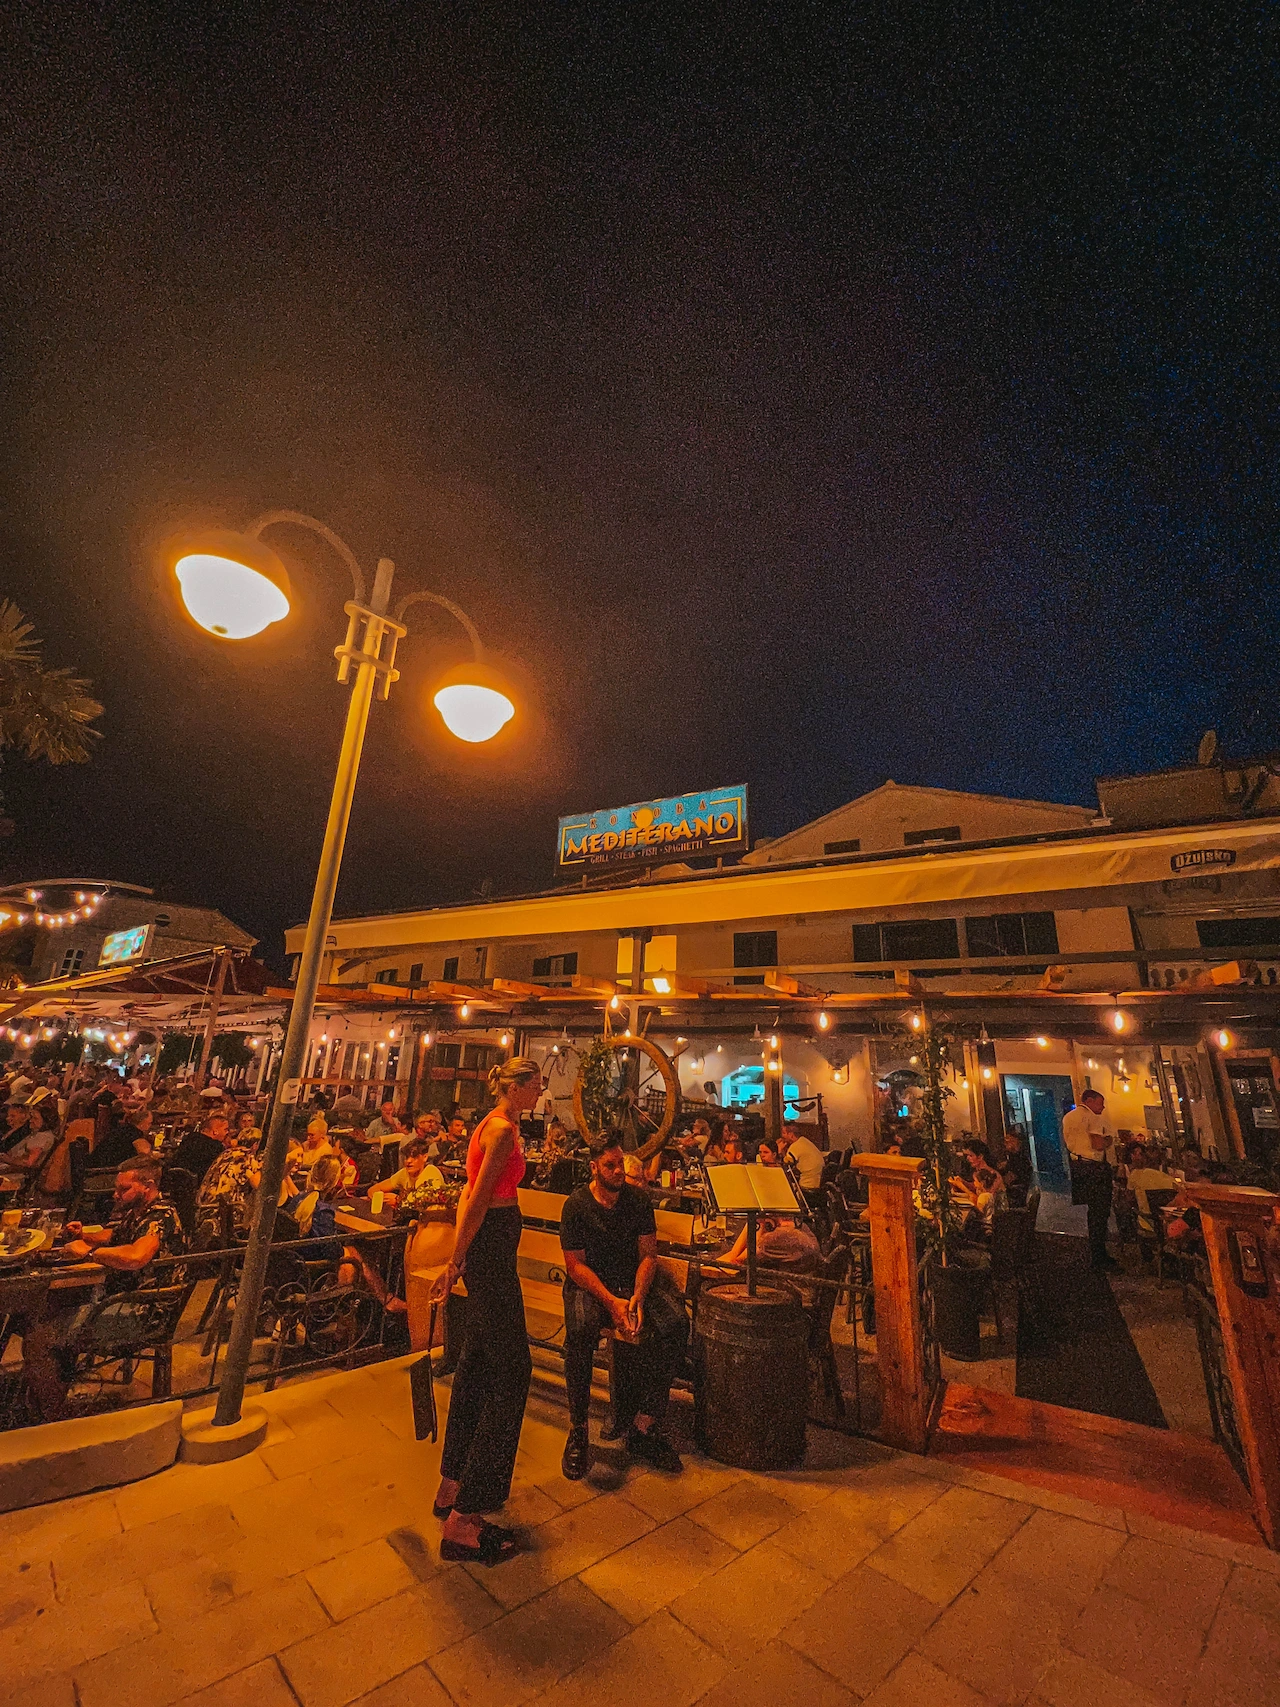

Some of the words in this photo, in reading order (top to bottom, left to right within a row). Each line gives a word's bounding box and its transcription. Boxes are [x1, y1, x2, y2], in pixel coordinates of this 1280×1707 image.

[566, 811, 735, 857] MEDITERANO
[590, 854, 609, 865] GRILL
[615, 850, 636, 861] STEAK
[641, 847, 658, 858] FISH
[663, 839, 703, 854] SPAGHETTI
